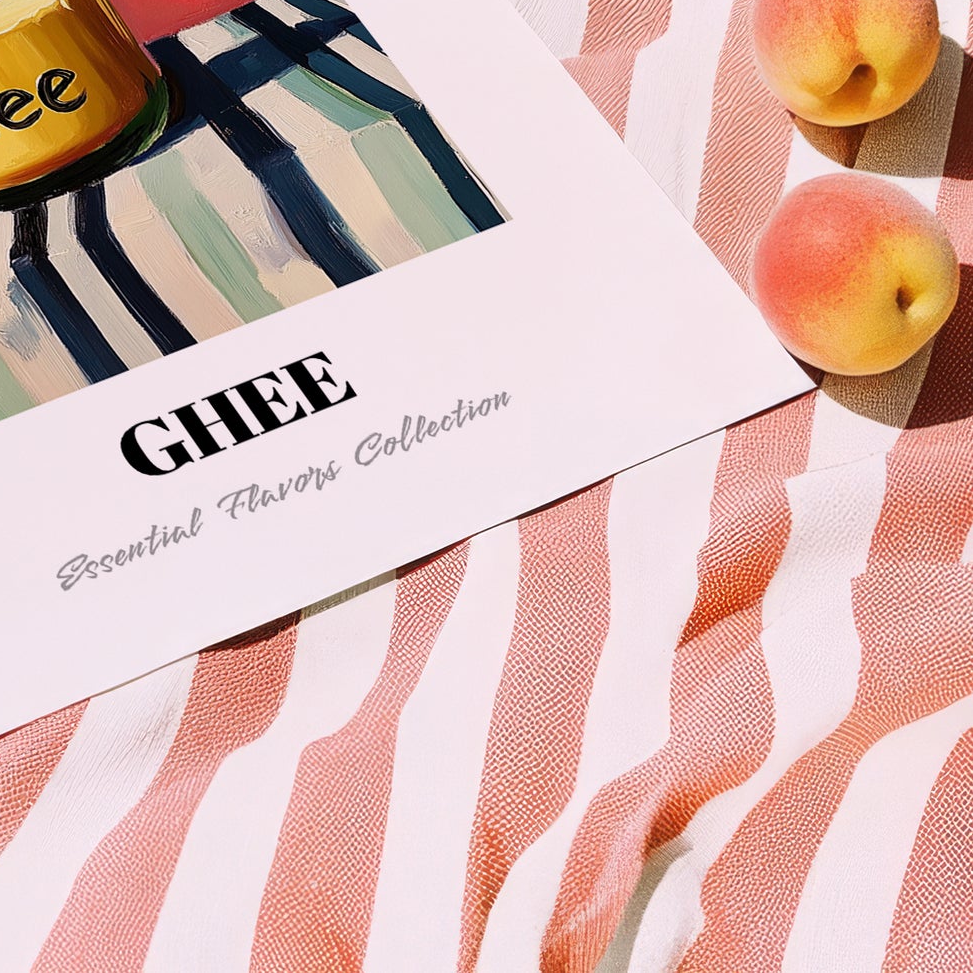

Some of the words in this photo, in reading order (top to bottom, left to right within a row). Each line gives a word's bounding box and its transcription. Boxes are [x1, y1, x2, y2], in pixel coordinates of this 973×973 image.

[57, 508, 204, 591] Essential
[217, 456, 342, 520] Flavors
[354, 391, 512, 467] Collection
[120, 351, 357, 476] GHEE
